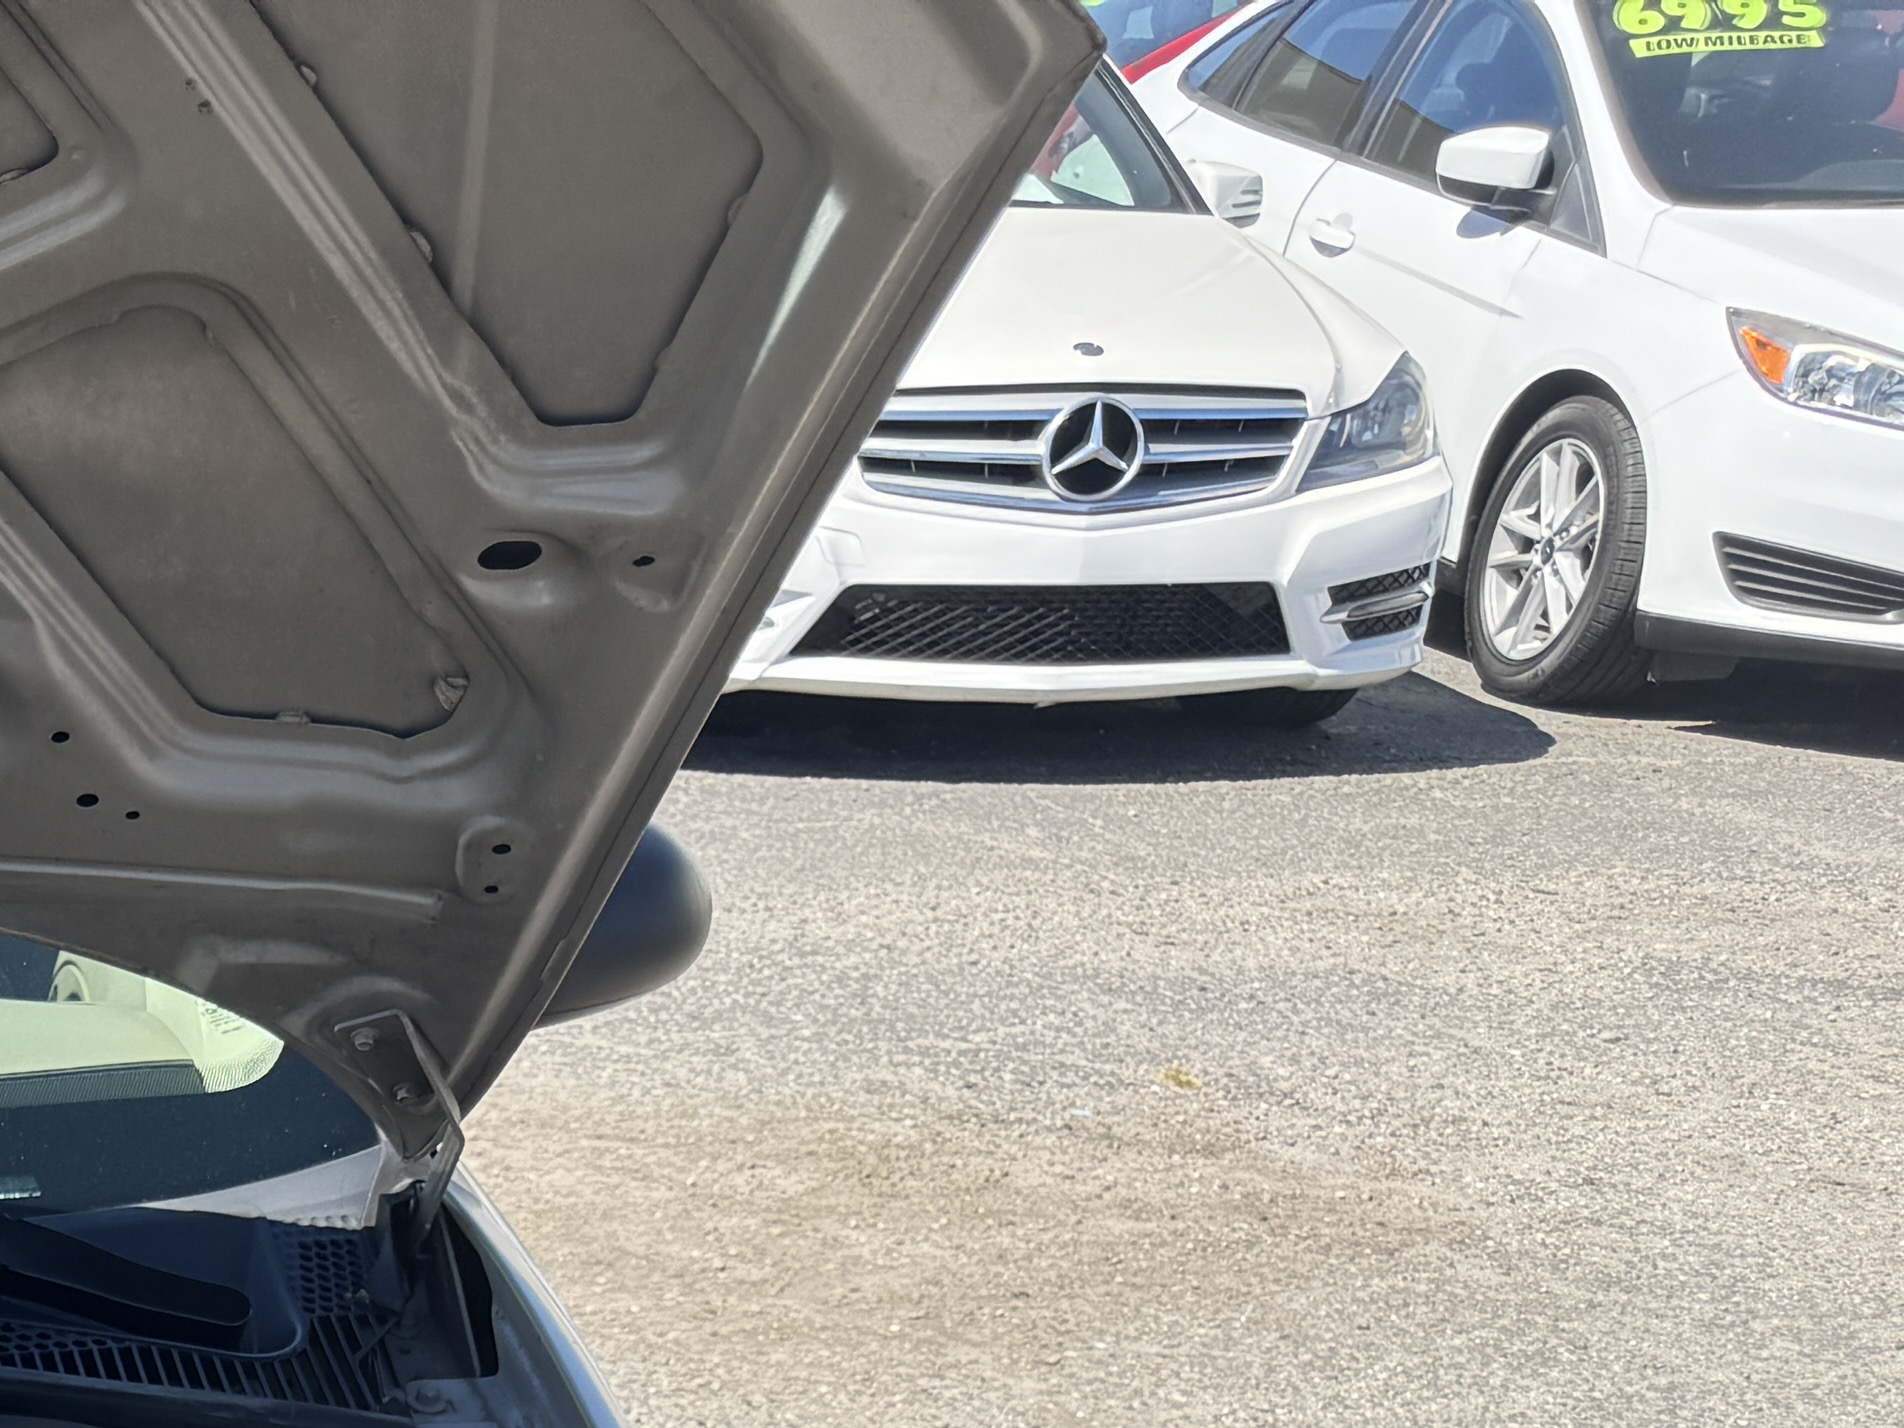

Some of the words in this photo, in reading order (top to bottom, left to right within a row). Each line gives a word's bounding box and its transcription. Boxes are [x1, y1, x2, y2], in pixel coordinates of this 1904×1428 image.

[1613, 0, 1828, 34] 6995
[1645, 37, 1698, 51] LOW
[1704, 33, 1811, 48] MILEAGE
